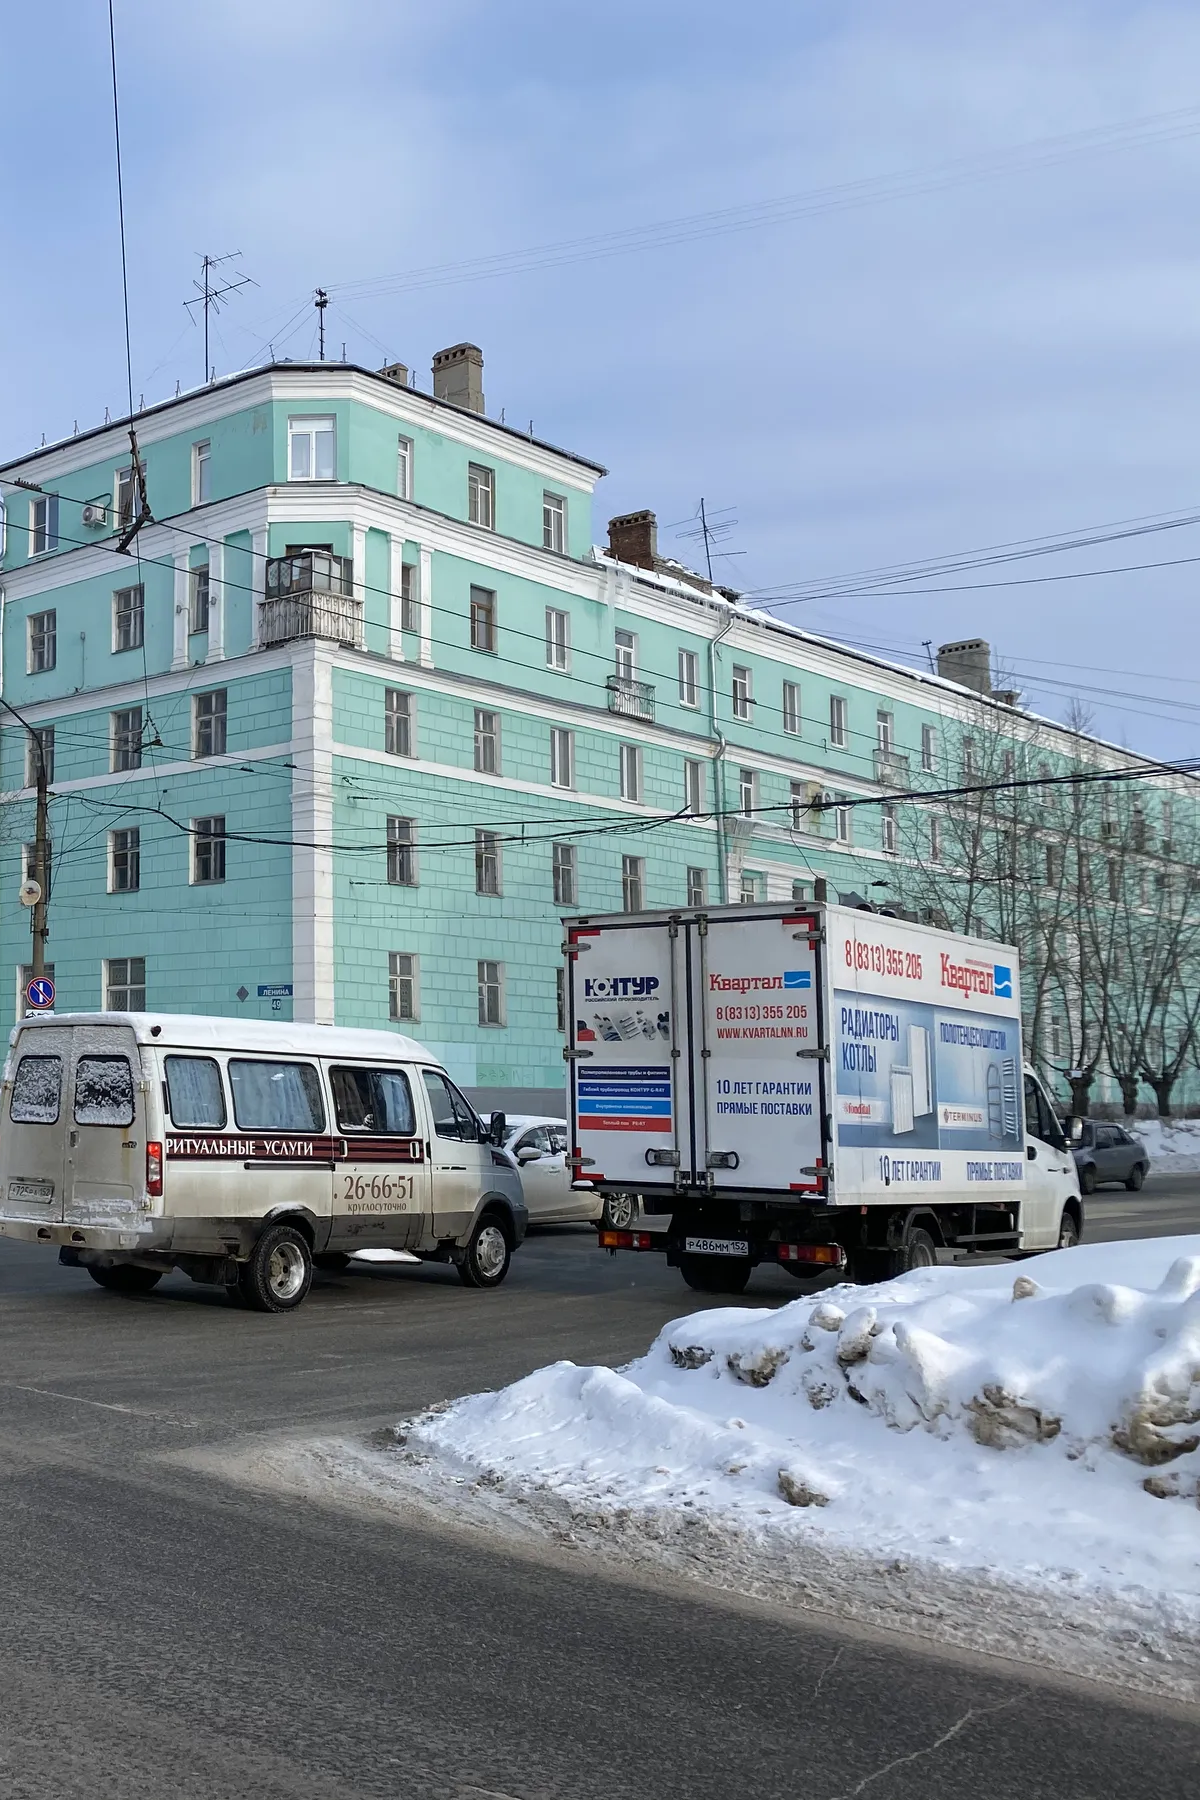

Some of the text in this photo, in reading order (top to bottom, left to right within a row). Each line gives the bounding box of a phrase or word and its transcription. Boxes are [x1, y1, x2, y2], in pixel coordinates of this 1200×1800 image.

[886, 948, 903, 977] 355
[905, 952, 922, 980] 205
[709, 973, 783, 994] Квартал
[940, 952, 994, 999] Квартал
[584, 976, 660, 997] КОНТУР
[272, 1000, 281, 1010] 49
[762, 1006, 783, 1019] 355
[786, 1005, 807, 1019] 205
[716, 1026, 808, 1039] WWW.KVARTALNN.RU
[841, 1007, 900, 1042] РАДИАТОРЫ
[842, 1042, 878, 1073] КОТЛЫ
[716, 1080, 812, 1095] 10 ЛЕТ ГАРАНТИИ
[717, 1102, 812, 1116] ПРЯМЫЕ ПОСТАВКИ
[949, 1111, 983, 1123] TERMINUS
[166, 1138, 313, 1156] РИТУАЛЬНЫЕ УСЛУГИ
[879, 1155, 942, 1182] 10 ЛЕТ ГАРАНТИИ
[343, 1174, 414, 1200] 26-66-51
[347, 1202, 407, 1215] круглосуточно
[730, 1241, 746, 1251] 152
